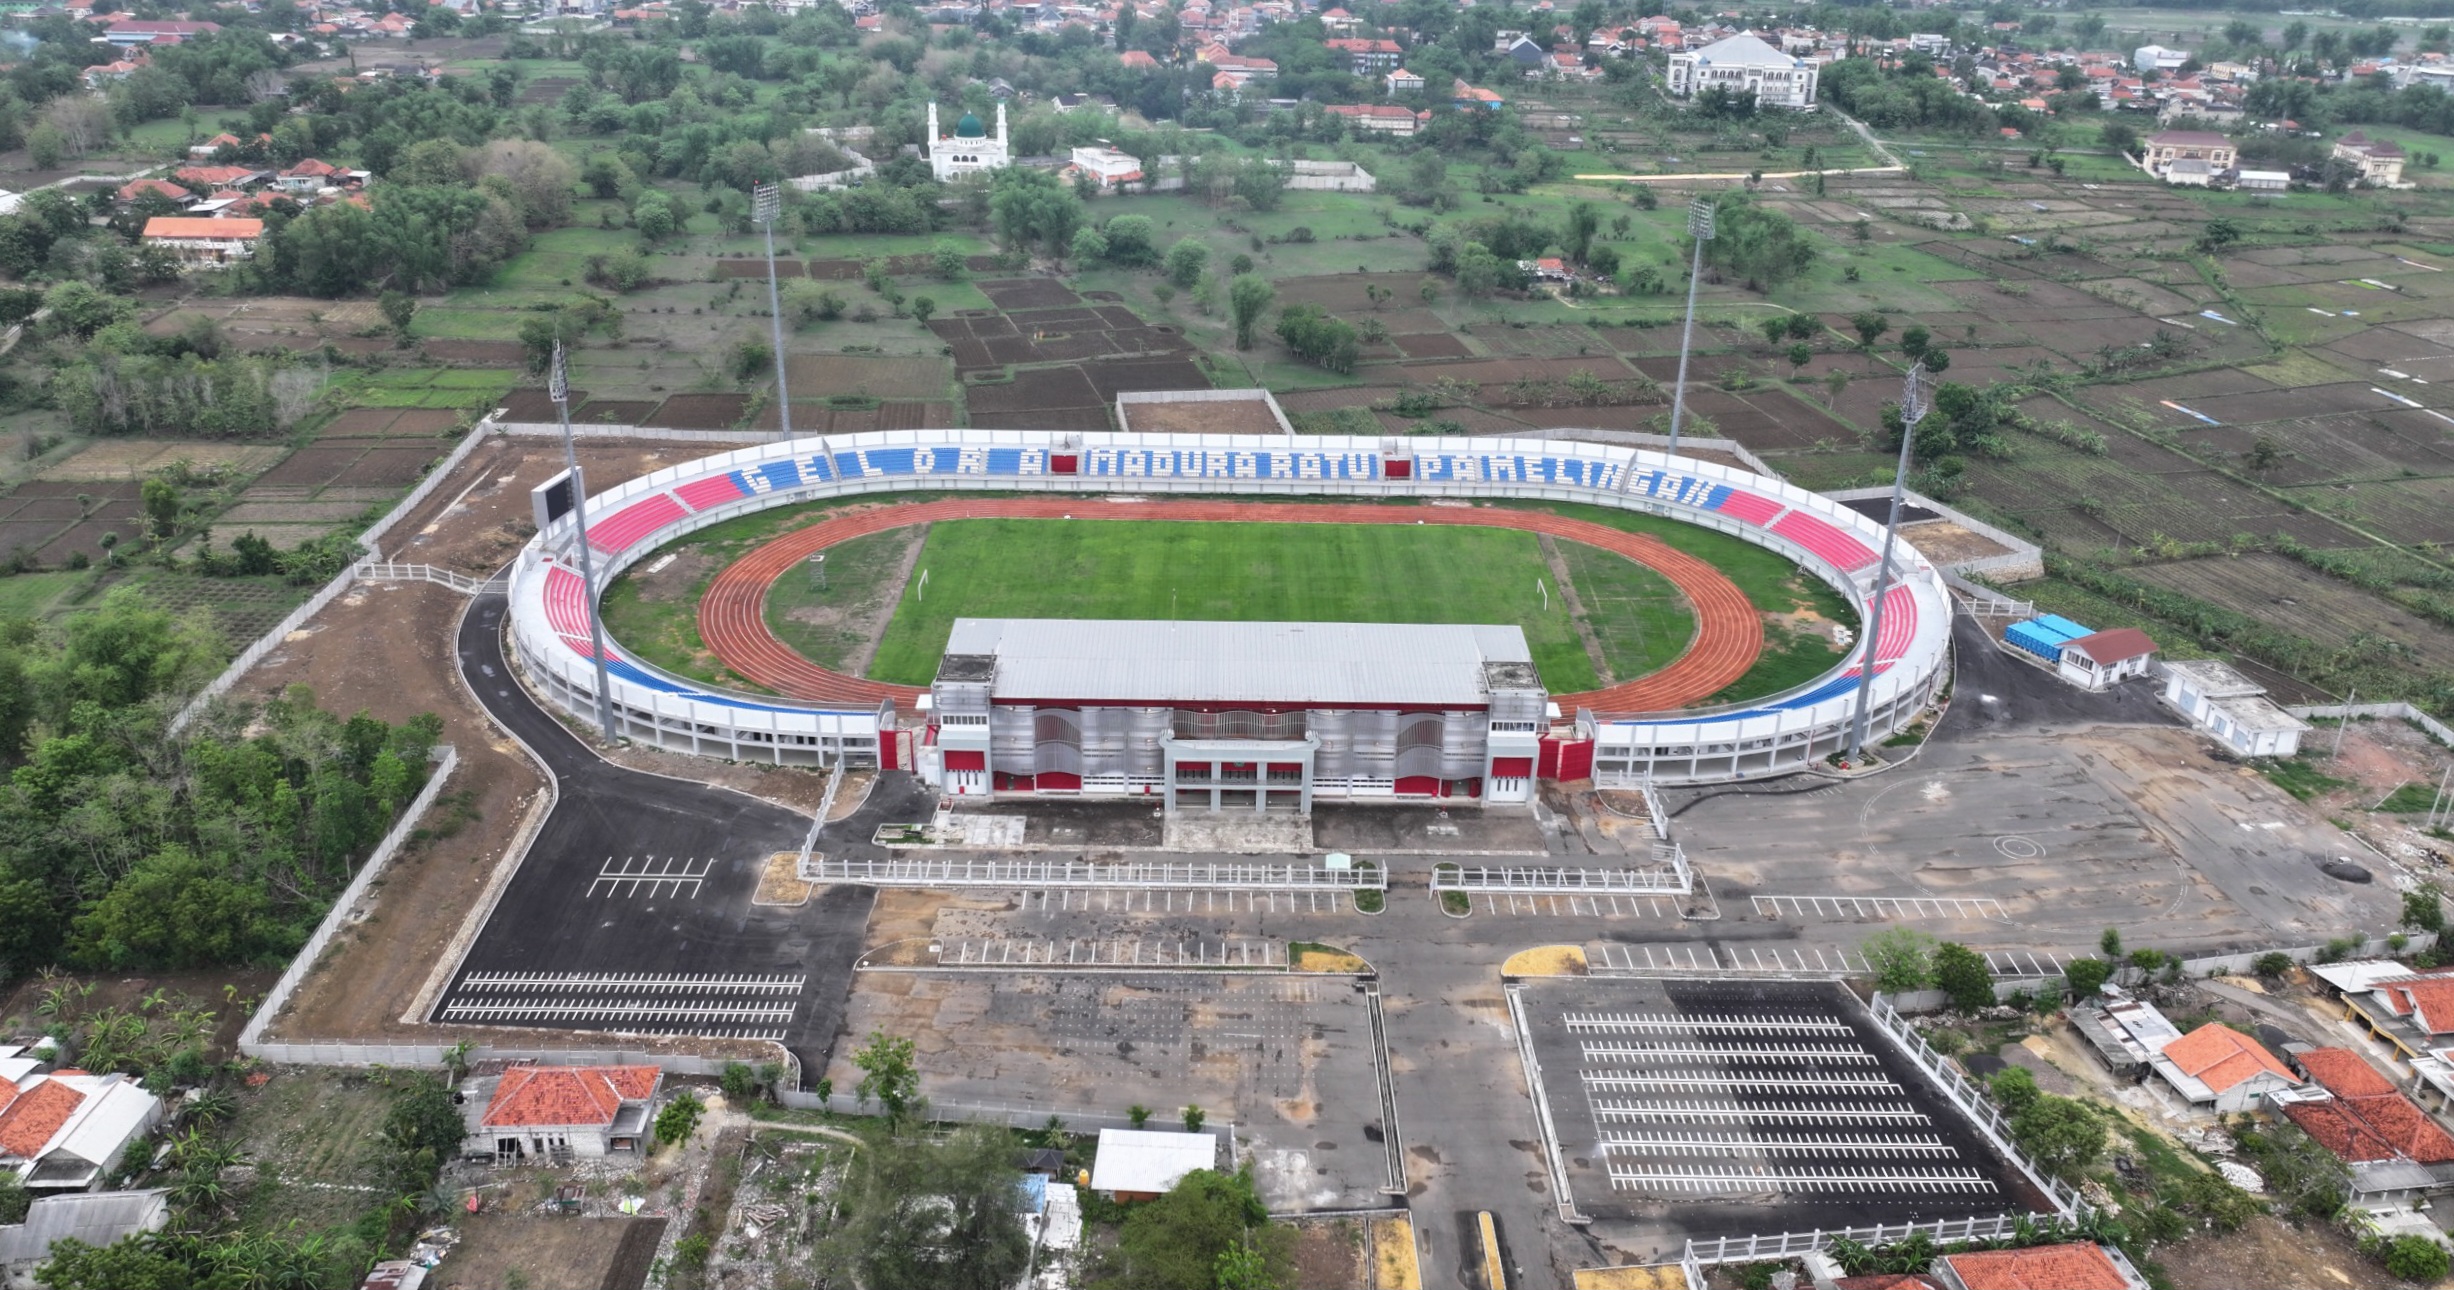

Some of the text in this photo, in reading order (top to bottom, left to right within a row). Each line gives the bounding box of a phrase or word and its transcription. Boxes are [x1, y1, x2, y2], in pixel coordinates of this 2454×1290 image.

[742, 448, 1717, 506] GELORA MADURA RATU PAMELINGAN
